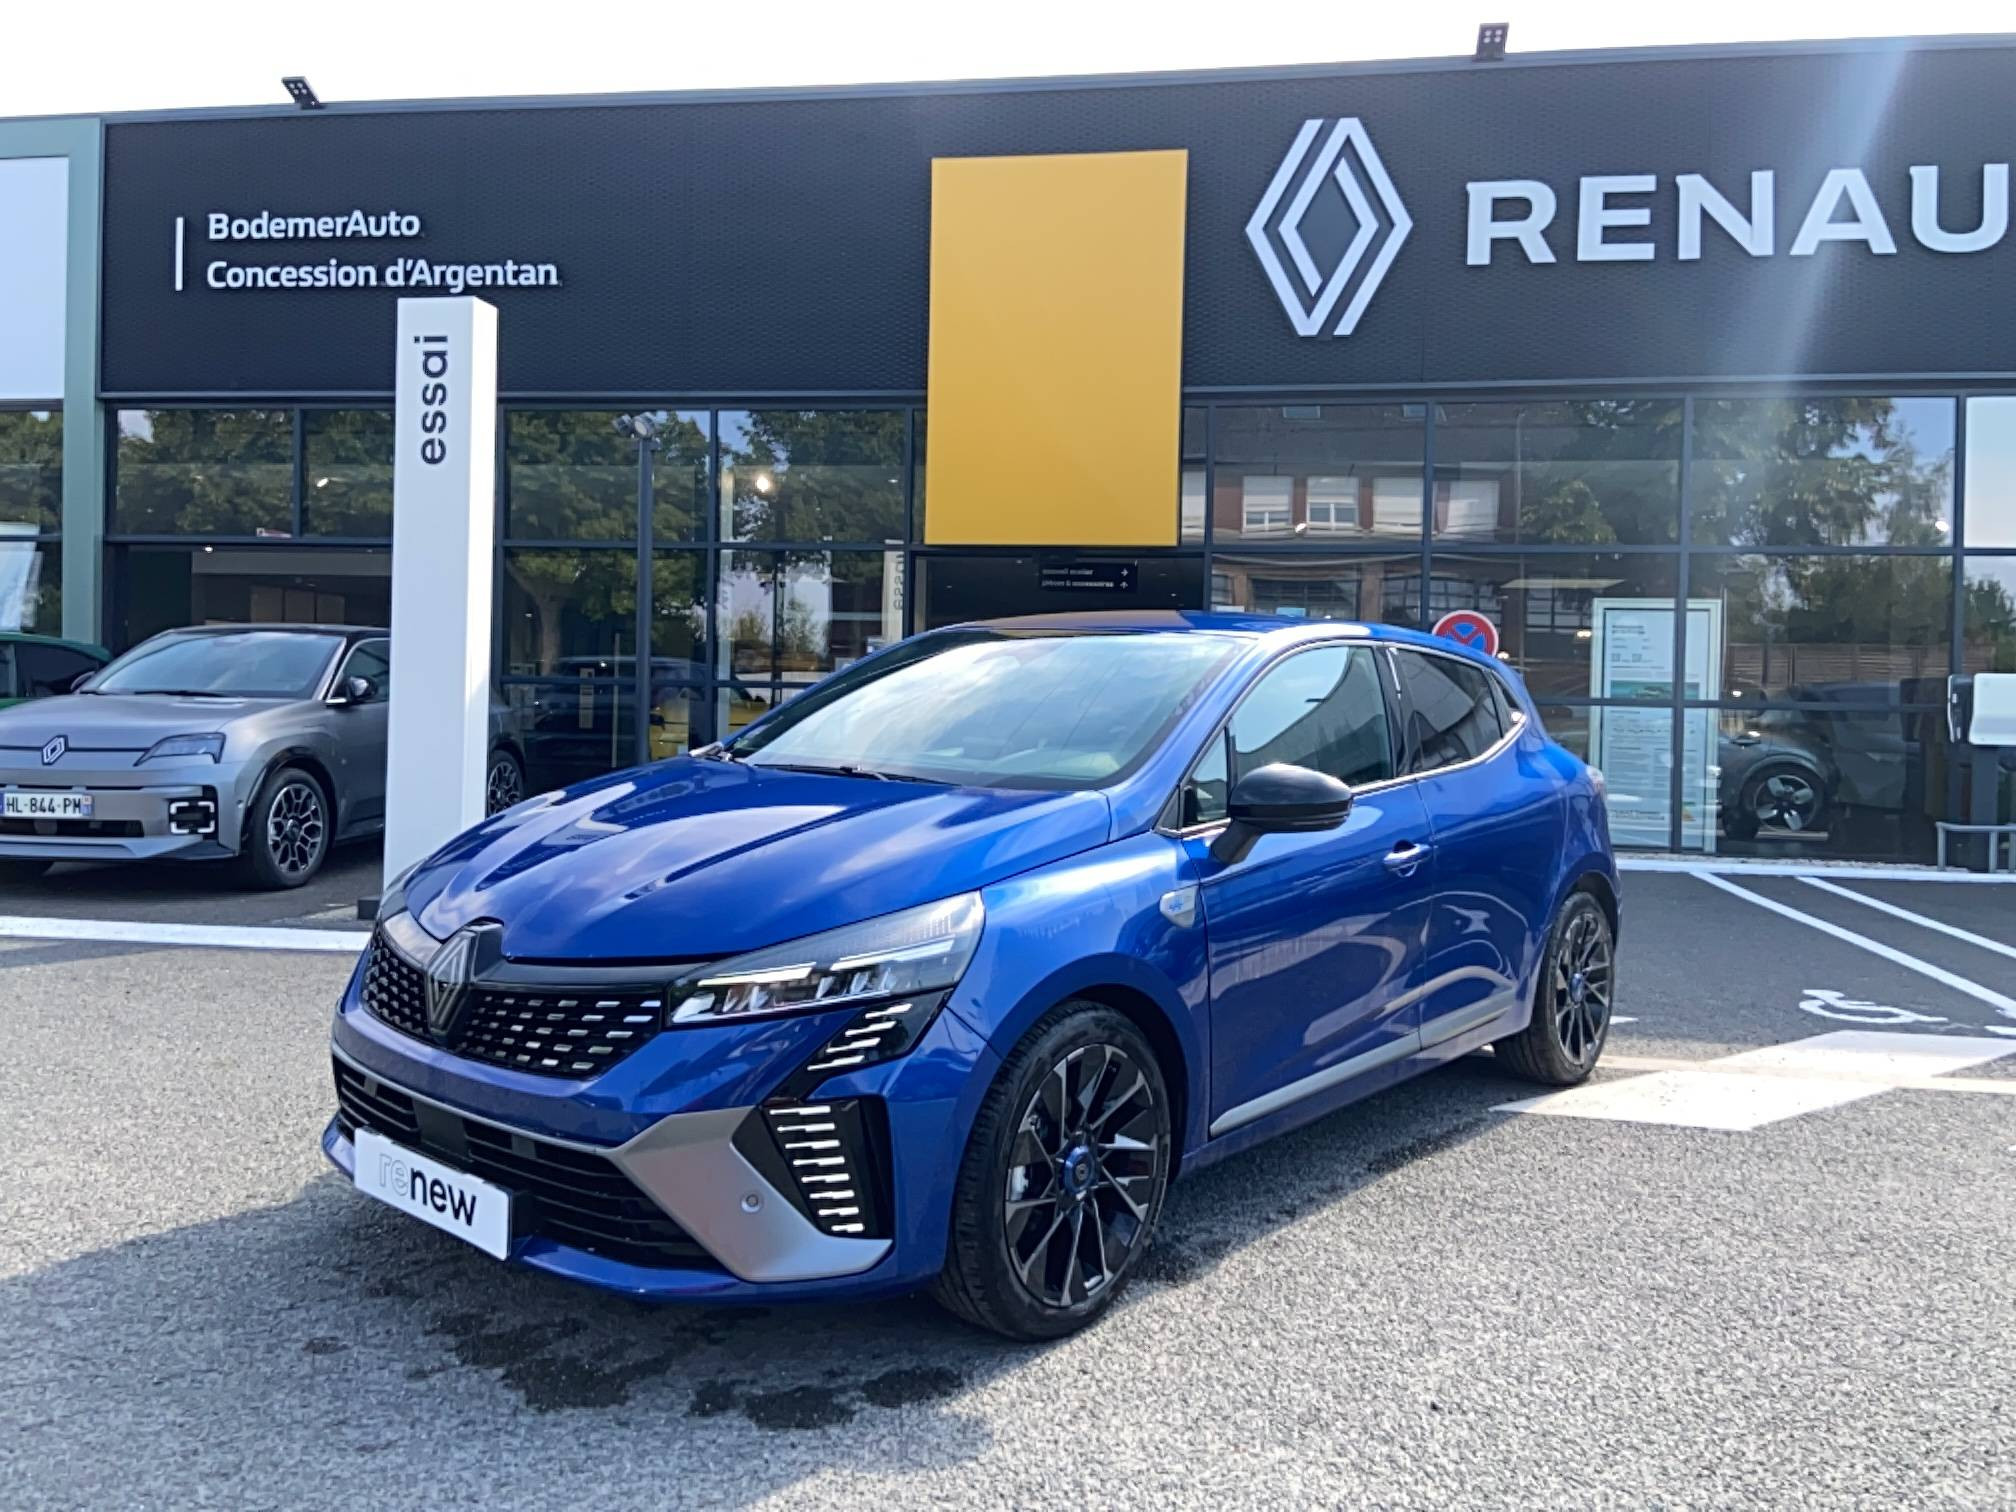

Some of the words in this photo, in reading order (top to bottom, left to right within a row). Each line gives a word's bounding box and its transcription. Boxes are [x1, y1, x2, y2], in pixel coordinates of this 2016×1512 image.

[208, 210, 420, 240] BodemerAuto
[1466, 163, 2010, 265] RENAU
[206, 258, 378, 288] Concession
[385, 257, 559, 293] d'Argentan
[413, 335, 448, 465] essai
[378, 1153, 477, 1227] renew
